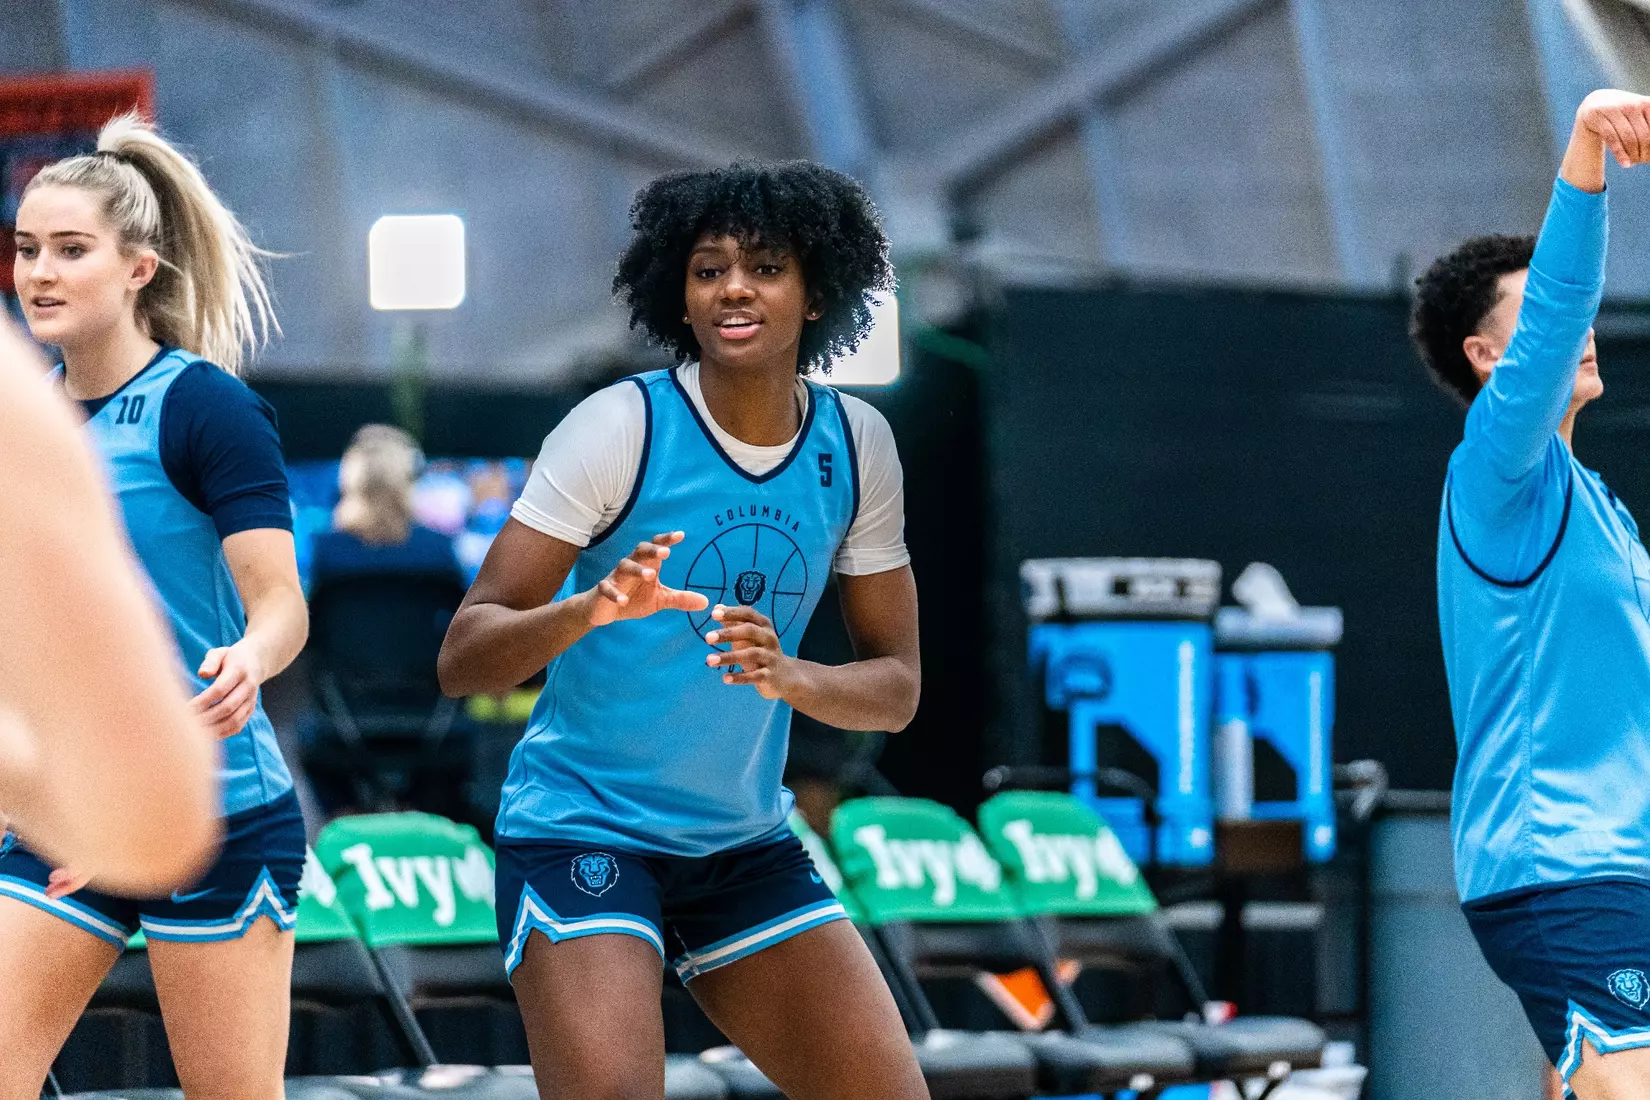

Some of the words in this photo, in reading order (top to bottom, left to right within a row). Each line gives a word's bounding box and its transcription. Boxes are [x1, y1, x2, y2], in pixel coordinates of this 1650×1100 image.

[115, 394, 146, 425] 10
[817, 453, 833, 488] 5
[714, 504, 800, 533] COLUMBIA
[340, 843, 457, 927] Ivy
[854, 824, 956, 907] Ivy
[1002, 819, 1099, 900] Ivy
